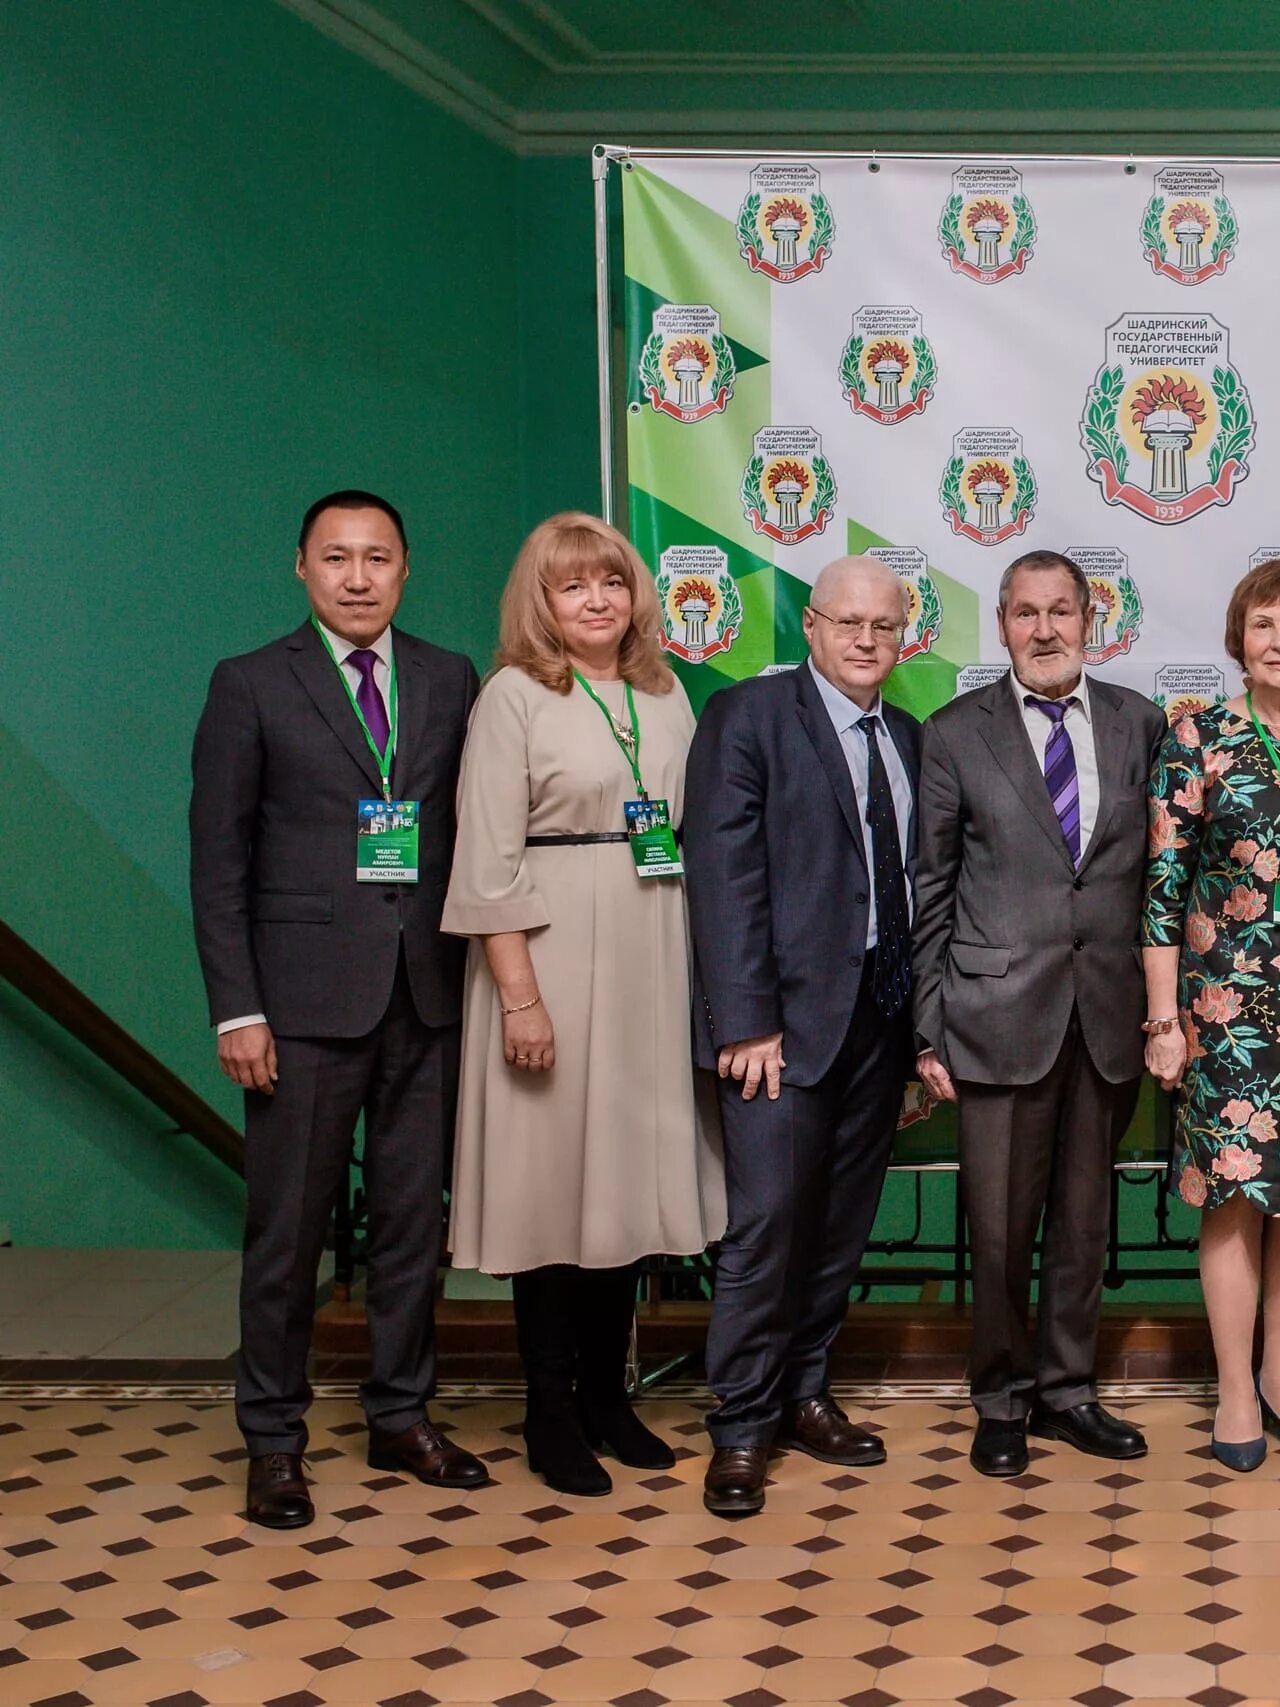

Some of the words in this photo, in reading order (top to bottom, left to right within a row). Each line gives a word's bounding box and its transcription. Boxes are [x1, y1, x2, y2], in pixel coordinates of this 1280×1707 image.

[1182, 274, 1198, 282] 1939
[1128, 319, 1207, 329] ШАДРИНСКИЙ
[1113, 331, 1222, 342] ГОСУДАРСТВЕННЫЙ
[1117, 343, 1218, 354] ПЕДАГОГИЧЕСКИЙ
[1130, 357, 1205, 366] УНИВЕРСИТЕТ
[1154, 506, 1183, 518] 1939
